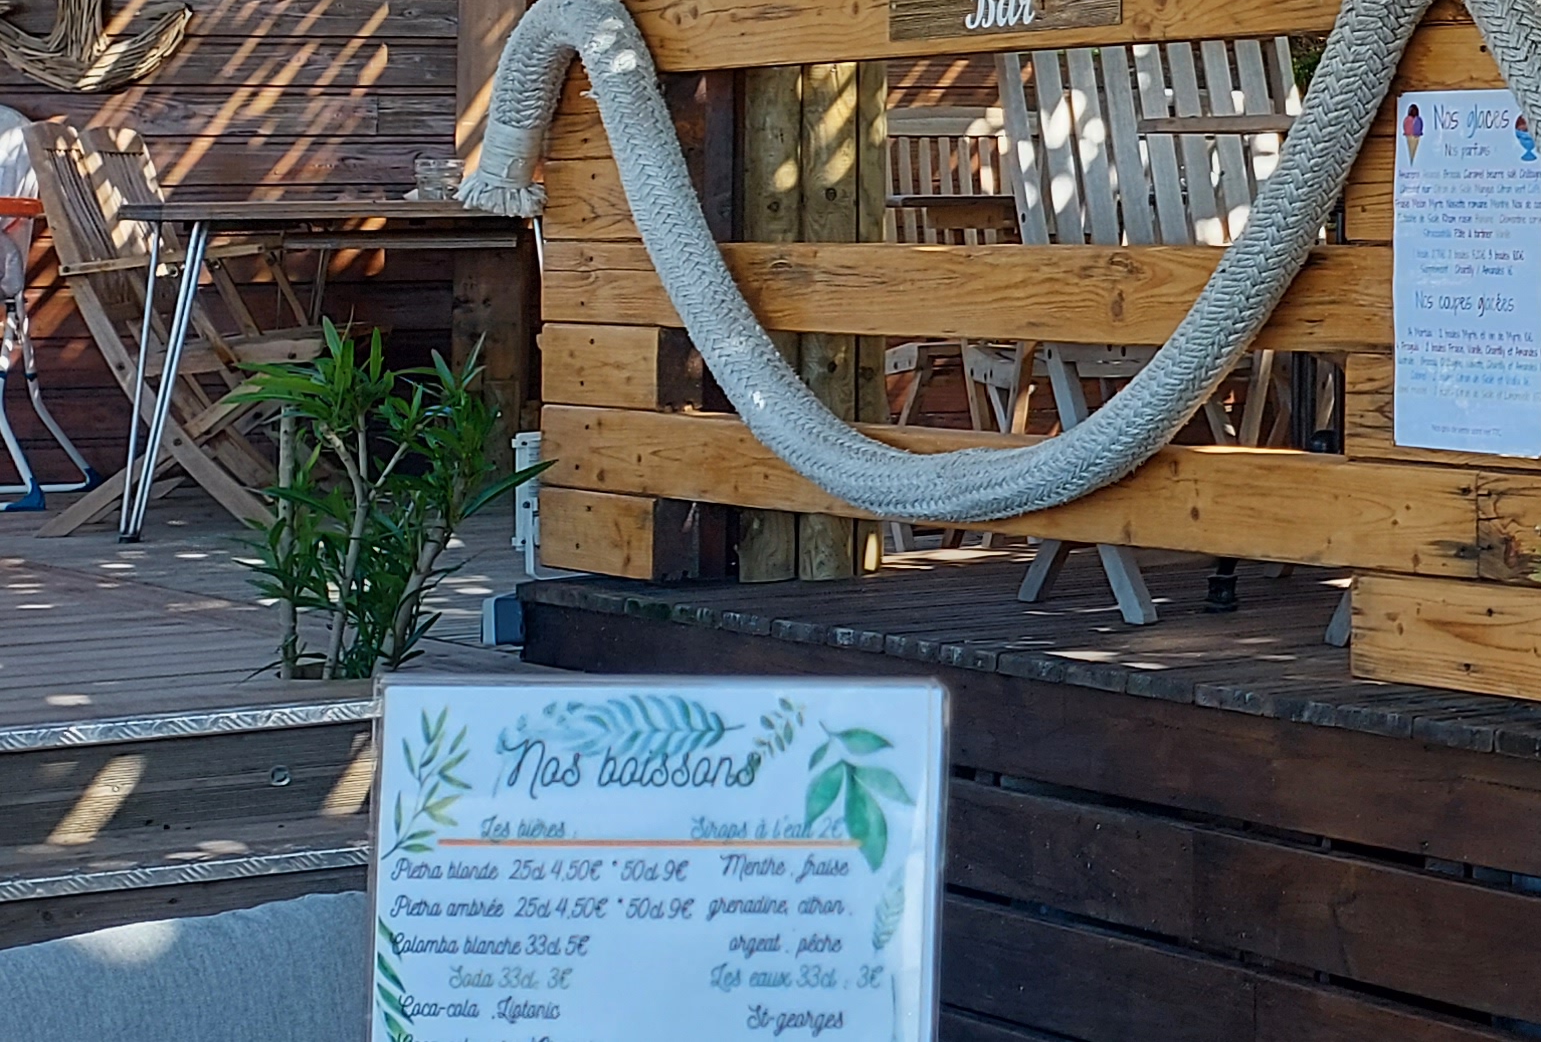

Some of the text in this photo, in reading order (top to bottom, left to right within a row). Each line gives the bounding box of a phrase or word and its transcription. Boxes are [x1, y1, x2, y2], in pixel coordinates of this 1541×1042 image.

[1434, 104, 1510, 138] Nos glaces
[1416, 291, 1515, 317] Nos coupes glacées
[502, 738, 761, 799] Nos boissons
[481, 814, 566, 843] Les bières
[690, 815, 748, 844] Sirops
[819, 817, 844, 839] 2€
[390, 858, 443, 880] Pietra
[447, 861, 499, 880] blonde
[508, 859, 546, 880] 25cl
[621, 860, 660, 882] 50cl
[663, 859, 689, 882] 9€
[720, 853, 849, 883] Menthe fraise
[389, 894, 442, 918] Pietra
[446, 898, 504, 918] ambrée
[514, 897, 552, 919] 25cl
[625, 897, 664, 919] 50cl
[667, 897, 695, 919] 9€
[797, 896, 845, 915] citron
[391, 932, 590, 956] Colomba blanche 33cl 5€
[728, 934, 843, 959] orgeat pêche
[449, 965, 494, 989] Soda
[547, 966, 573, 990] 3€
[710, 962, 883, 992] Les eaux 33cl 3€
[399, 995, 480, 1018] Coca-cola
[747, 1005, 844, 1037] St-georges
